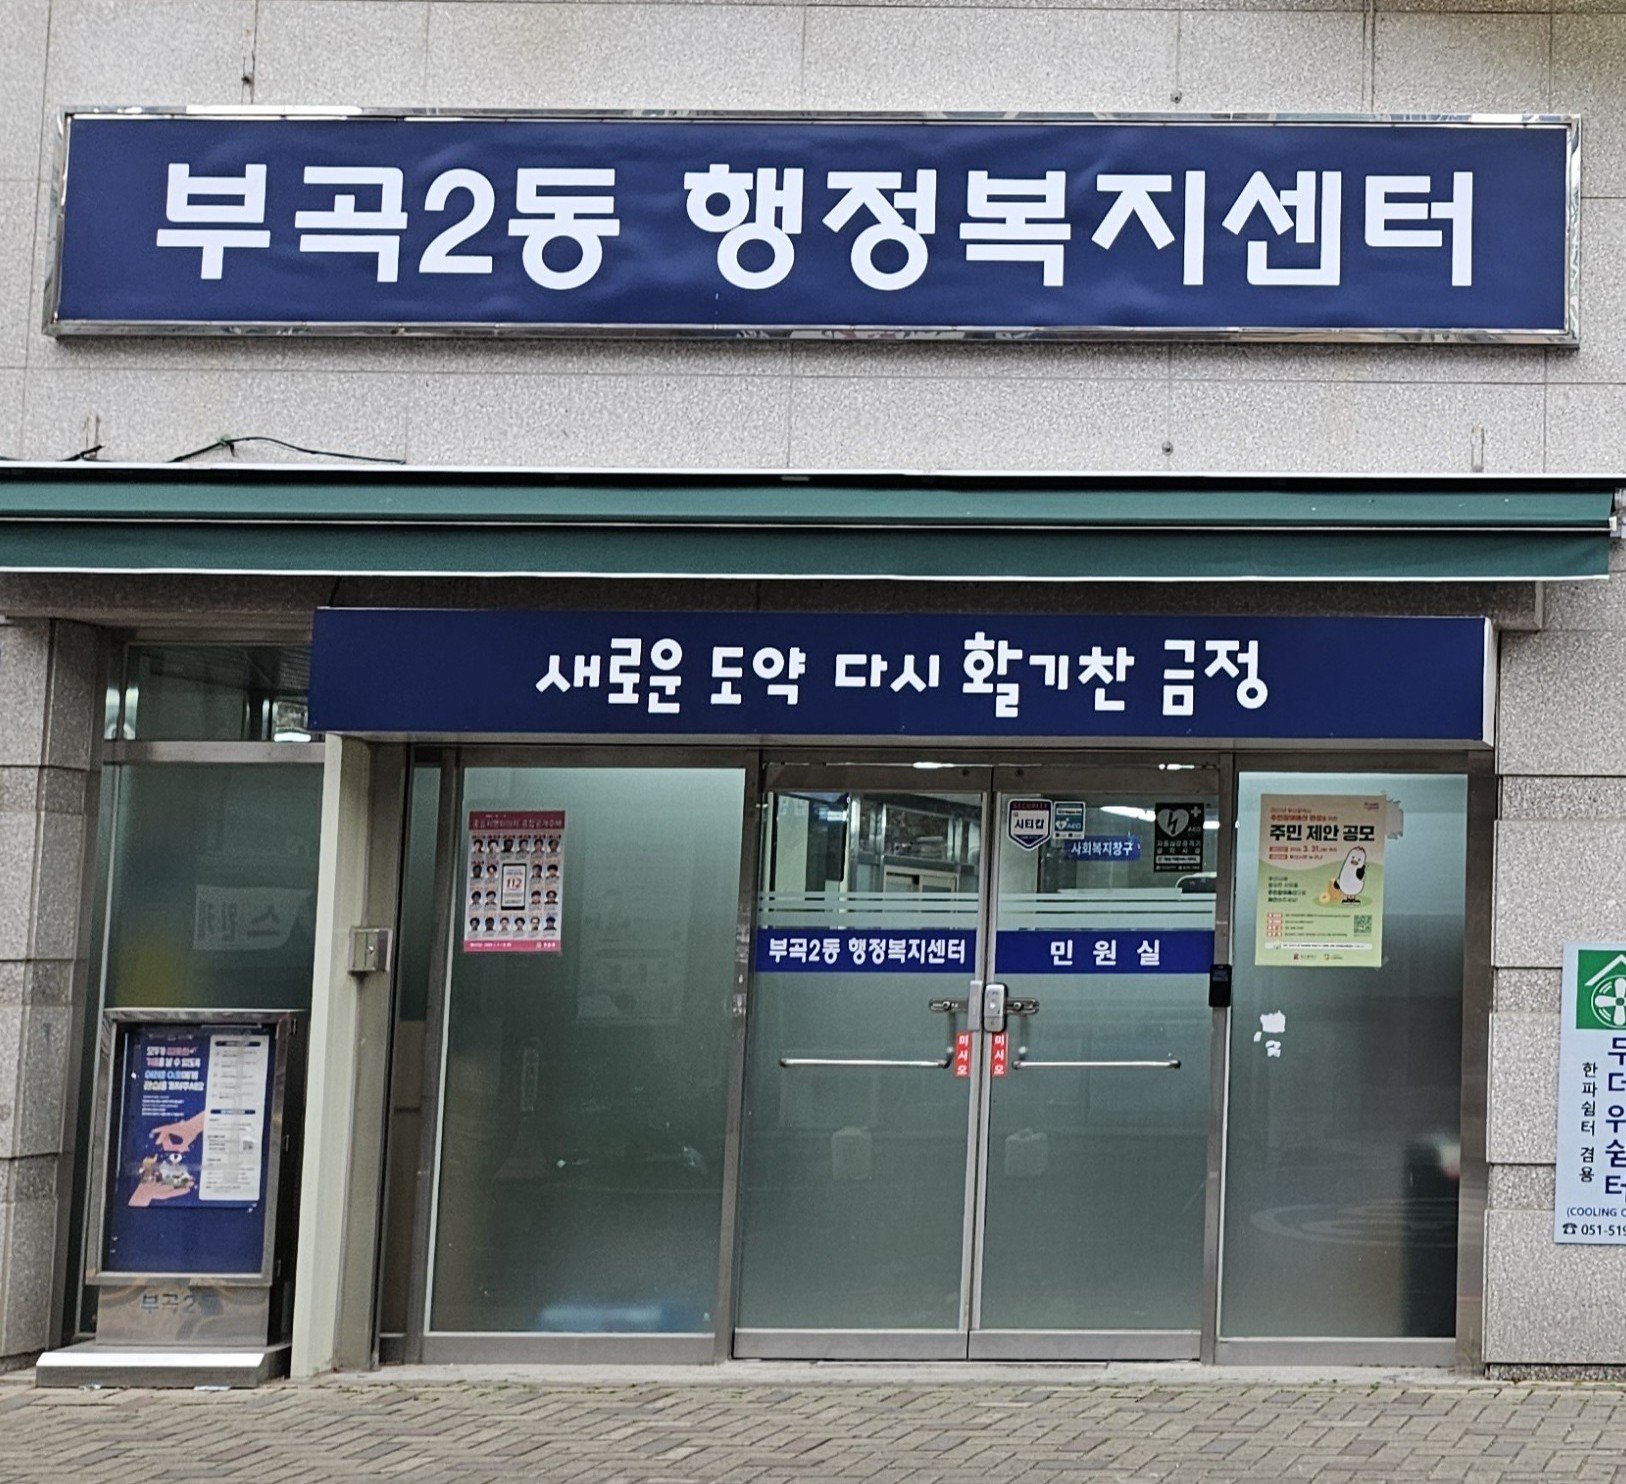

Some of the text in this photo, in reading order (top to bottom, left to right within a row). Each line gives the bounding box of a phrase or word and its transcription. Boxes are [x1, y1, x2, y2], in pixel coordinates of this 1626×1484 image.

[156, 161, 1473, 290] 부곡2동 행정복지센터
[536, 634, 1268, 721] 새로운 도약 다시 활기찬 금정
[1071, 842, 1133, 857] 사회복지창구
[1270, 825, 1375, 841] 주민 제안 공모
[769, 939, 966, 965] 부곡2동 행정복지센터
[957, 1035, 969, 1075] 미시오
[994, 1035, 1004, 1074] 미시오
[1579, 1062, 1597, 1183] 한파쉼터 겸용
[1567, 1207, 1618, 1218] (COOLING
